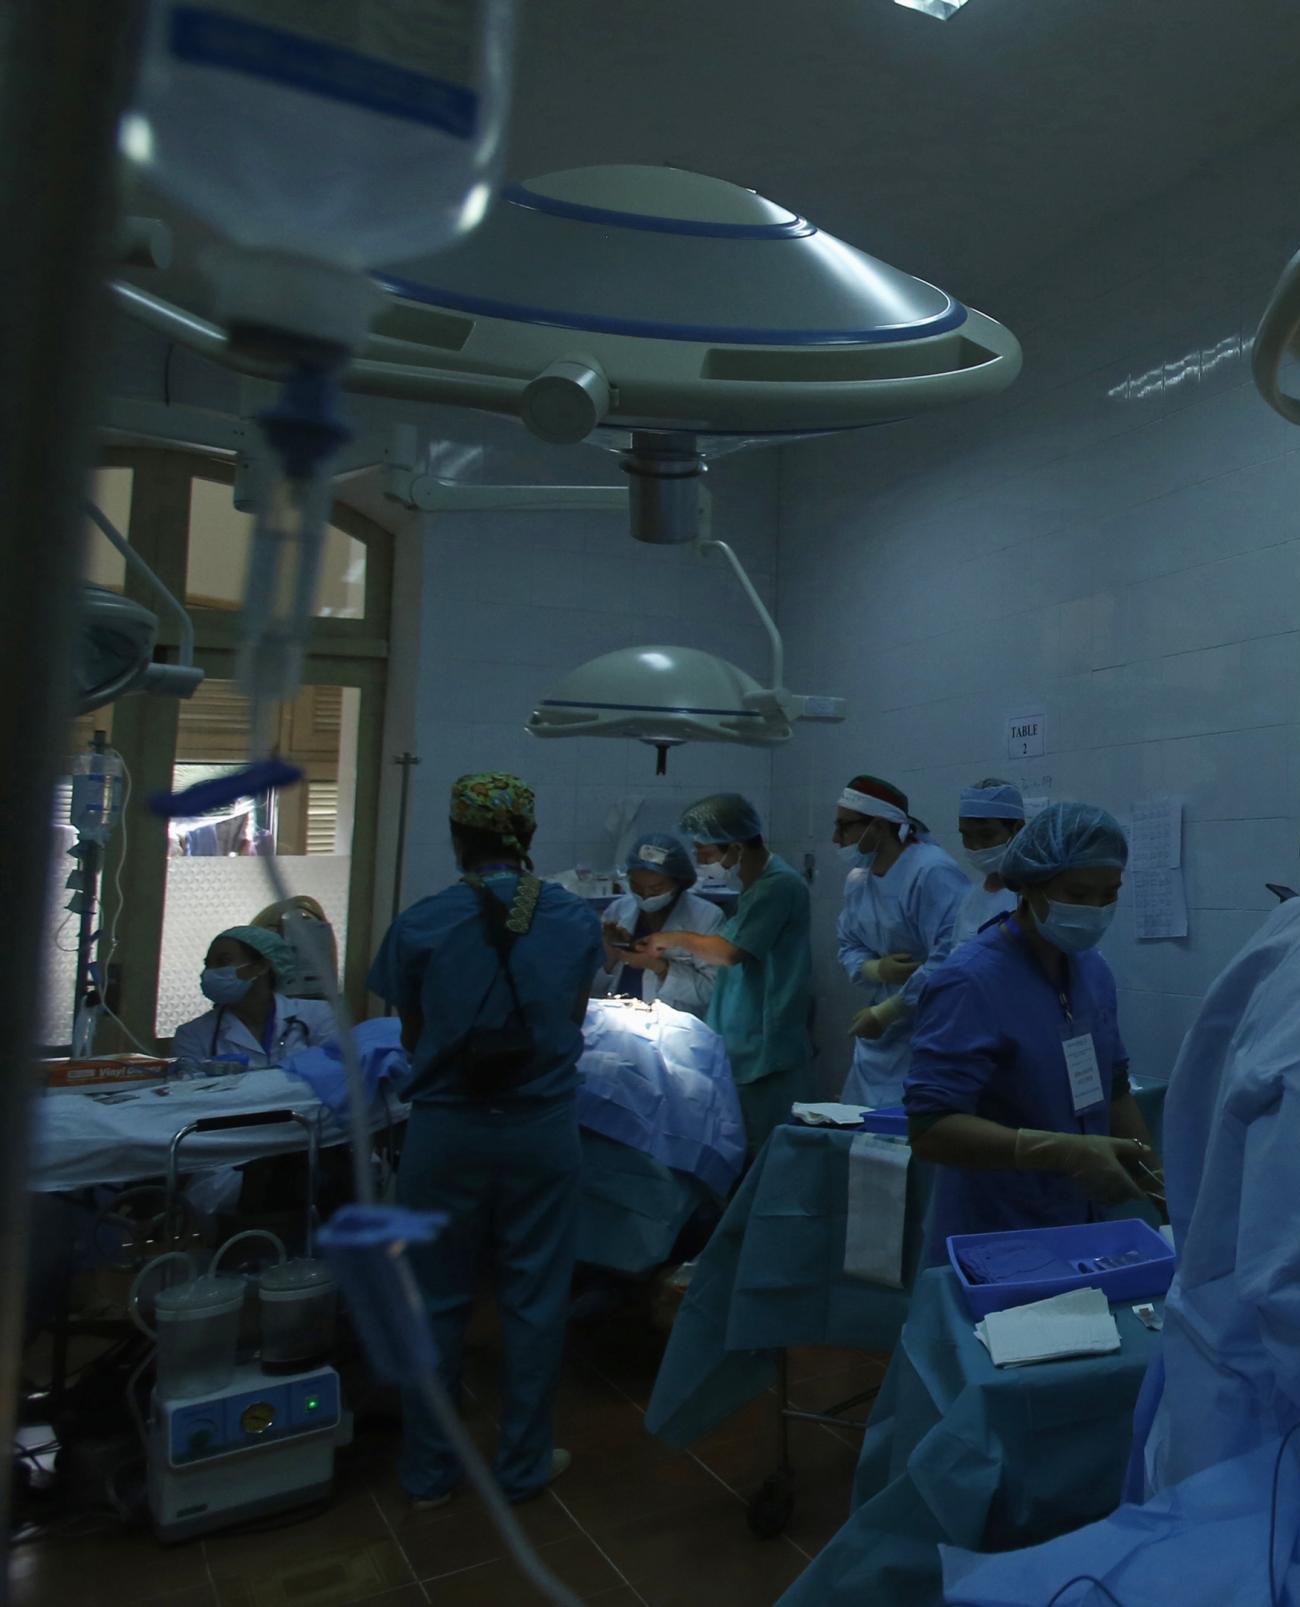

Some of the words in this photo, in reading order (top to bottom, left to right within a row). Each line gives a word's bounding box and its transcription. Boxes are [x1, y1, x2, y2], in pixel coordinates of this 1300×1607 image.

[1011, 724, 1038, 738] TABLE
[1022, 743, 1028, 754] 2
[98, 1065, 126, 1077] Vinyl
